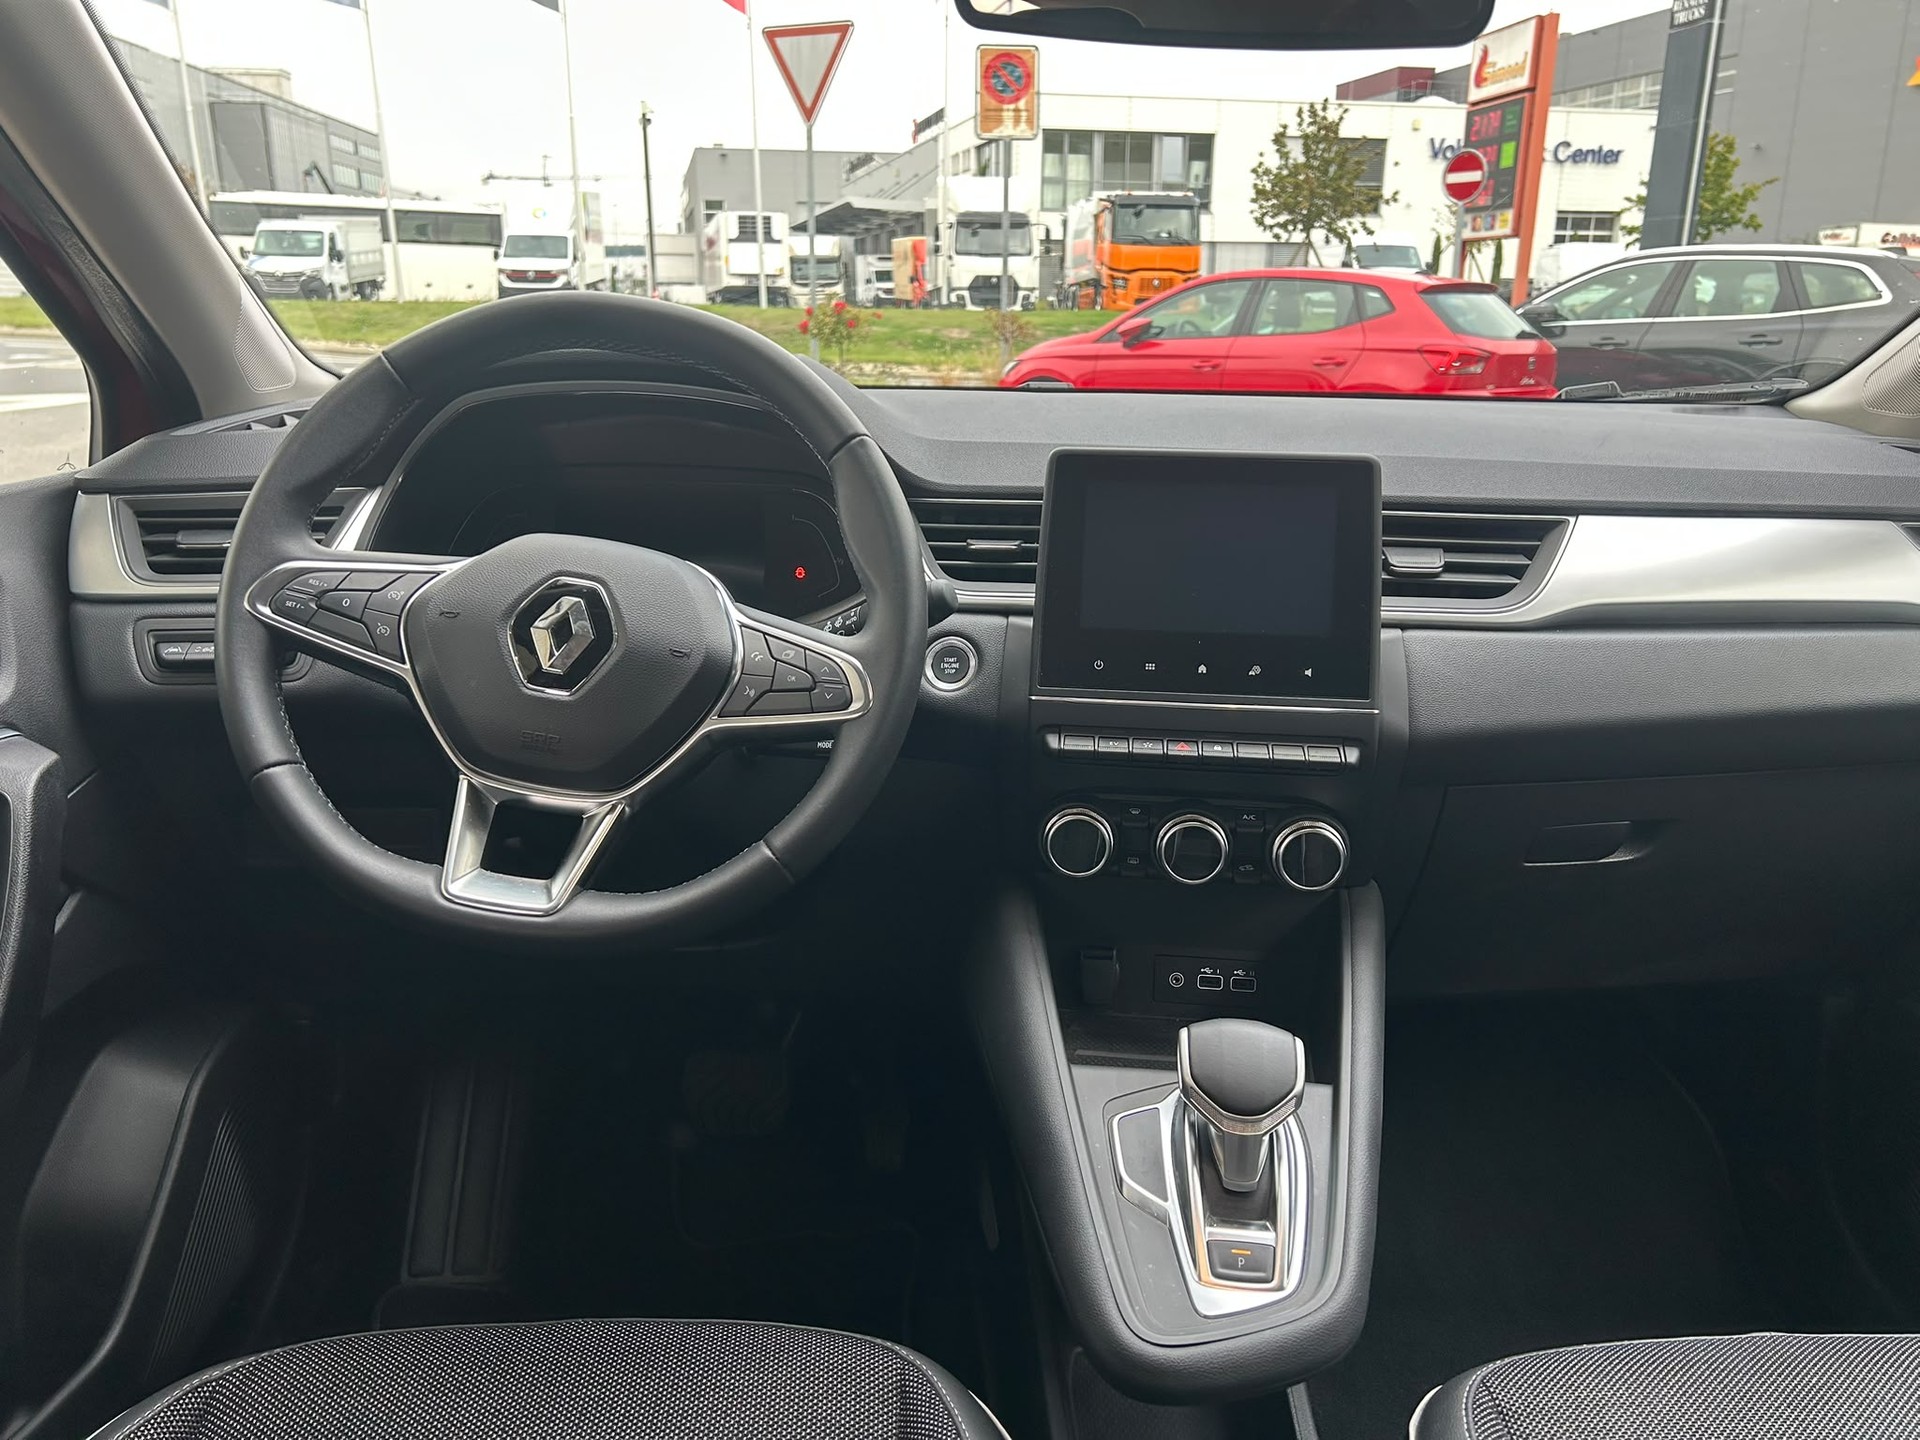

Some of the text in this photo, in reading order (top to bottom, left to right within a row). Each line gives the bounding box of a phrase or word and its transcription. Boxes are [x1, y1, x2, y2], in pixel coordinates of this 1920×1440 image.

[1673, 5, 1706, 26] TRUCKS
[1554, 140, 1624, 165] Center
[845, 616, 858, 626] AUTO
[817, 741, 834, 749] MODE
[1238, 1256, 1245, 1268] P
